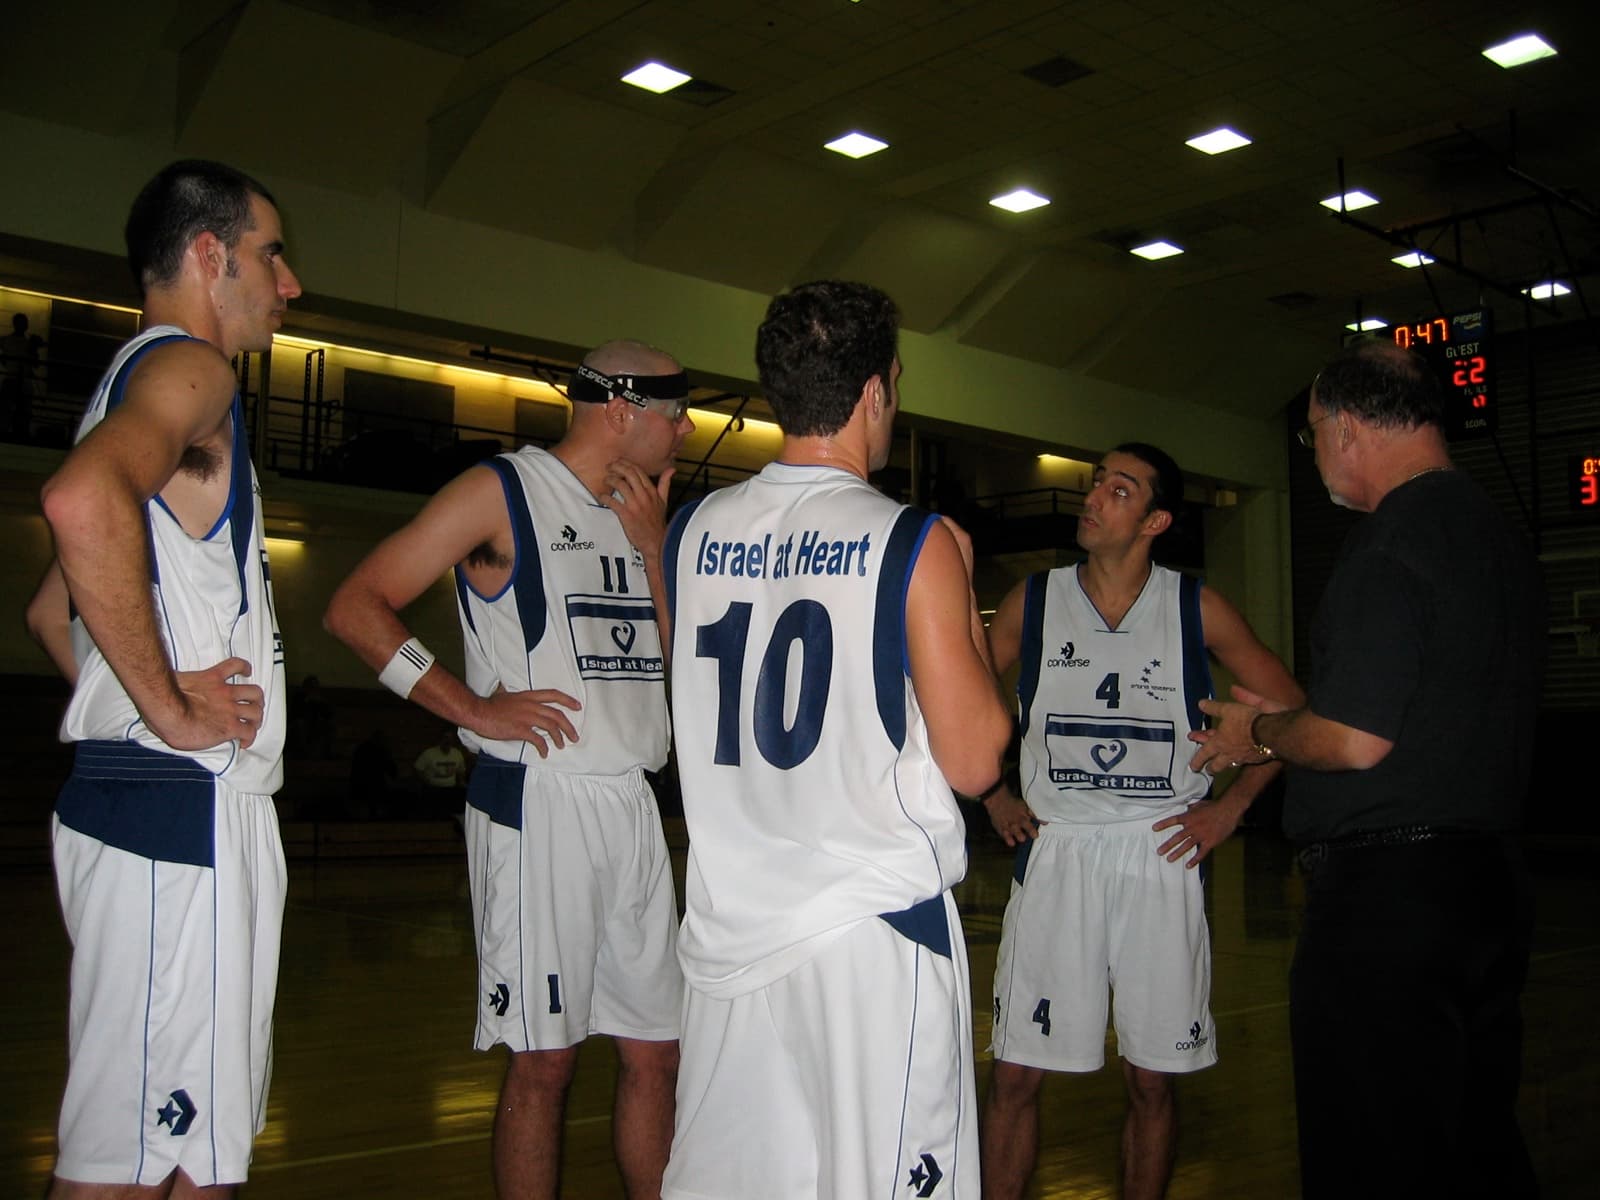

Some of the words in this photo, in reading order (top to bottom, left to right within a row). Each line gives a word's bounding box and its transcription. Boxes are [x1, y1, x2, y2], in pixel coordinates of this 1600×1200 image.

[551, 541, 595, 552] converse
[696, 531, 772, 579] Israel
[773, 532, 794, 579] at
[795, 531, 871, 577] Heart
[600, 555, 629, 594] 11
[581, 657, 622, 670] Israel
[625, 658, 638, 670] at
[1047, 658, 1090, 668] converse
[695, 598, 834, 770] 10
[1095, 672, 1120, 709] 4
[1052, 770, 1095, 785] Israel
[1099, 776, 1118, 788] at
[547, 974, 562, 1014] 1
[1032, 998, 1050, 1036] 4
